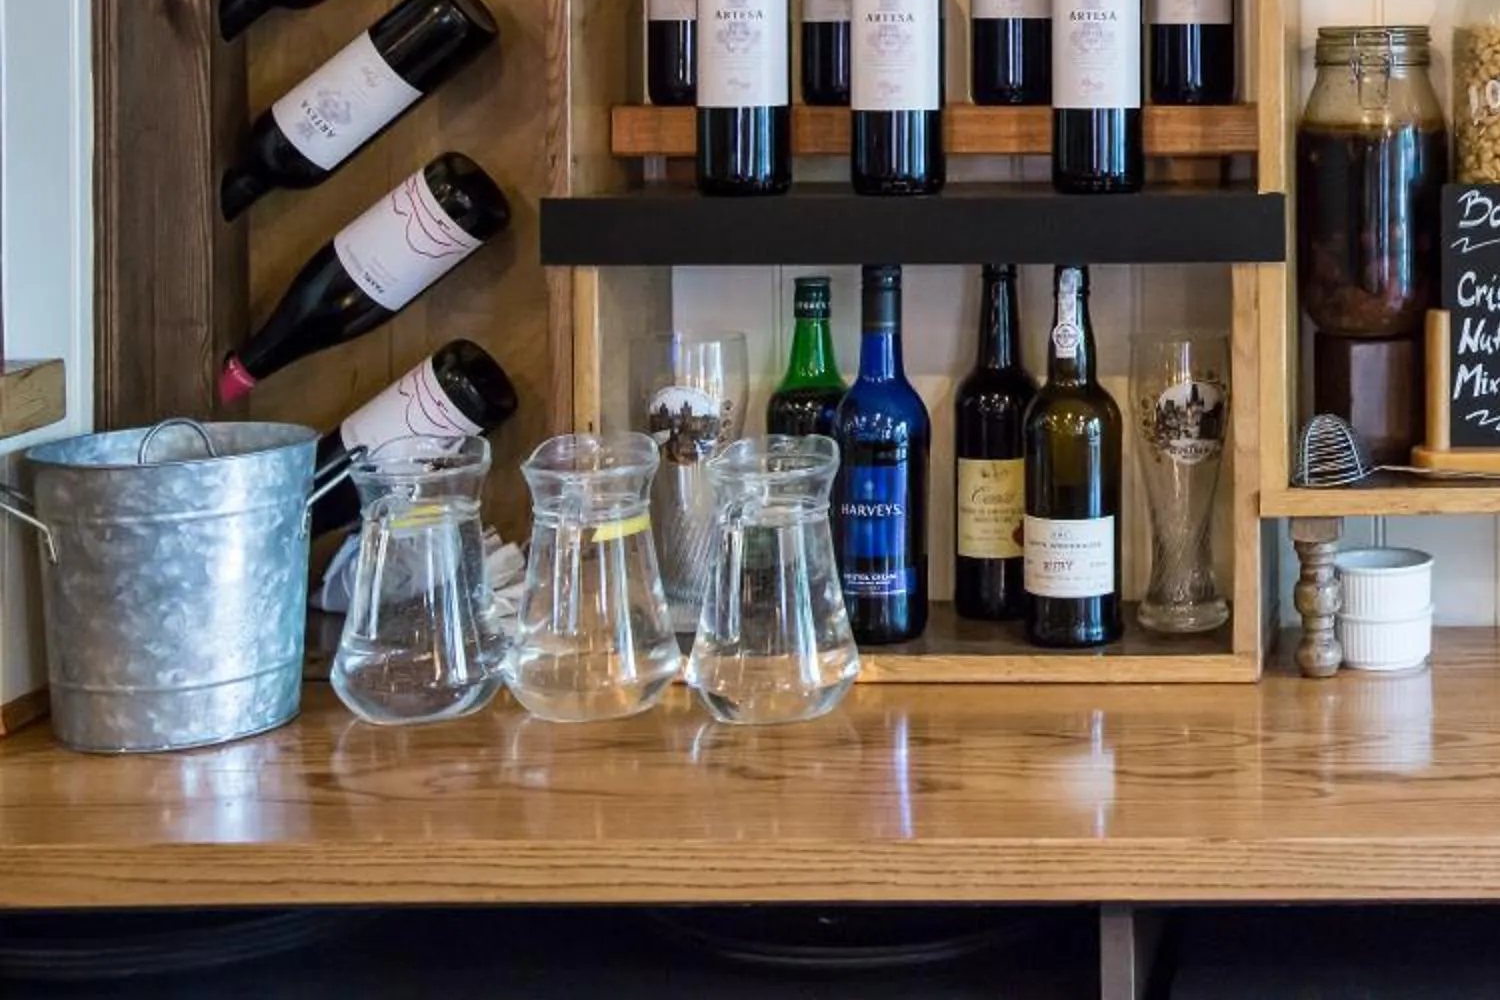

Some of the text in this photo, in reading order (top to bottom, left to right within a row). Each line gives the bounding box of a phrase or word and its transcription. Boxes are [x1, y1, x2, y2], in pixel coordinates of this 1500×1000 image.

[715, 9, 765, 20] ARTESA
[865, 13, 916, 23] ARTESA
[1069, 10, 1118, 21] ARTESA
[1453, 363, 1500, 400] Mix
[841, 503, 903, 517] HARVEYS
